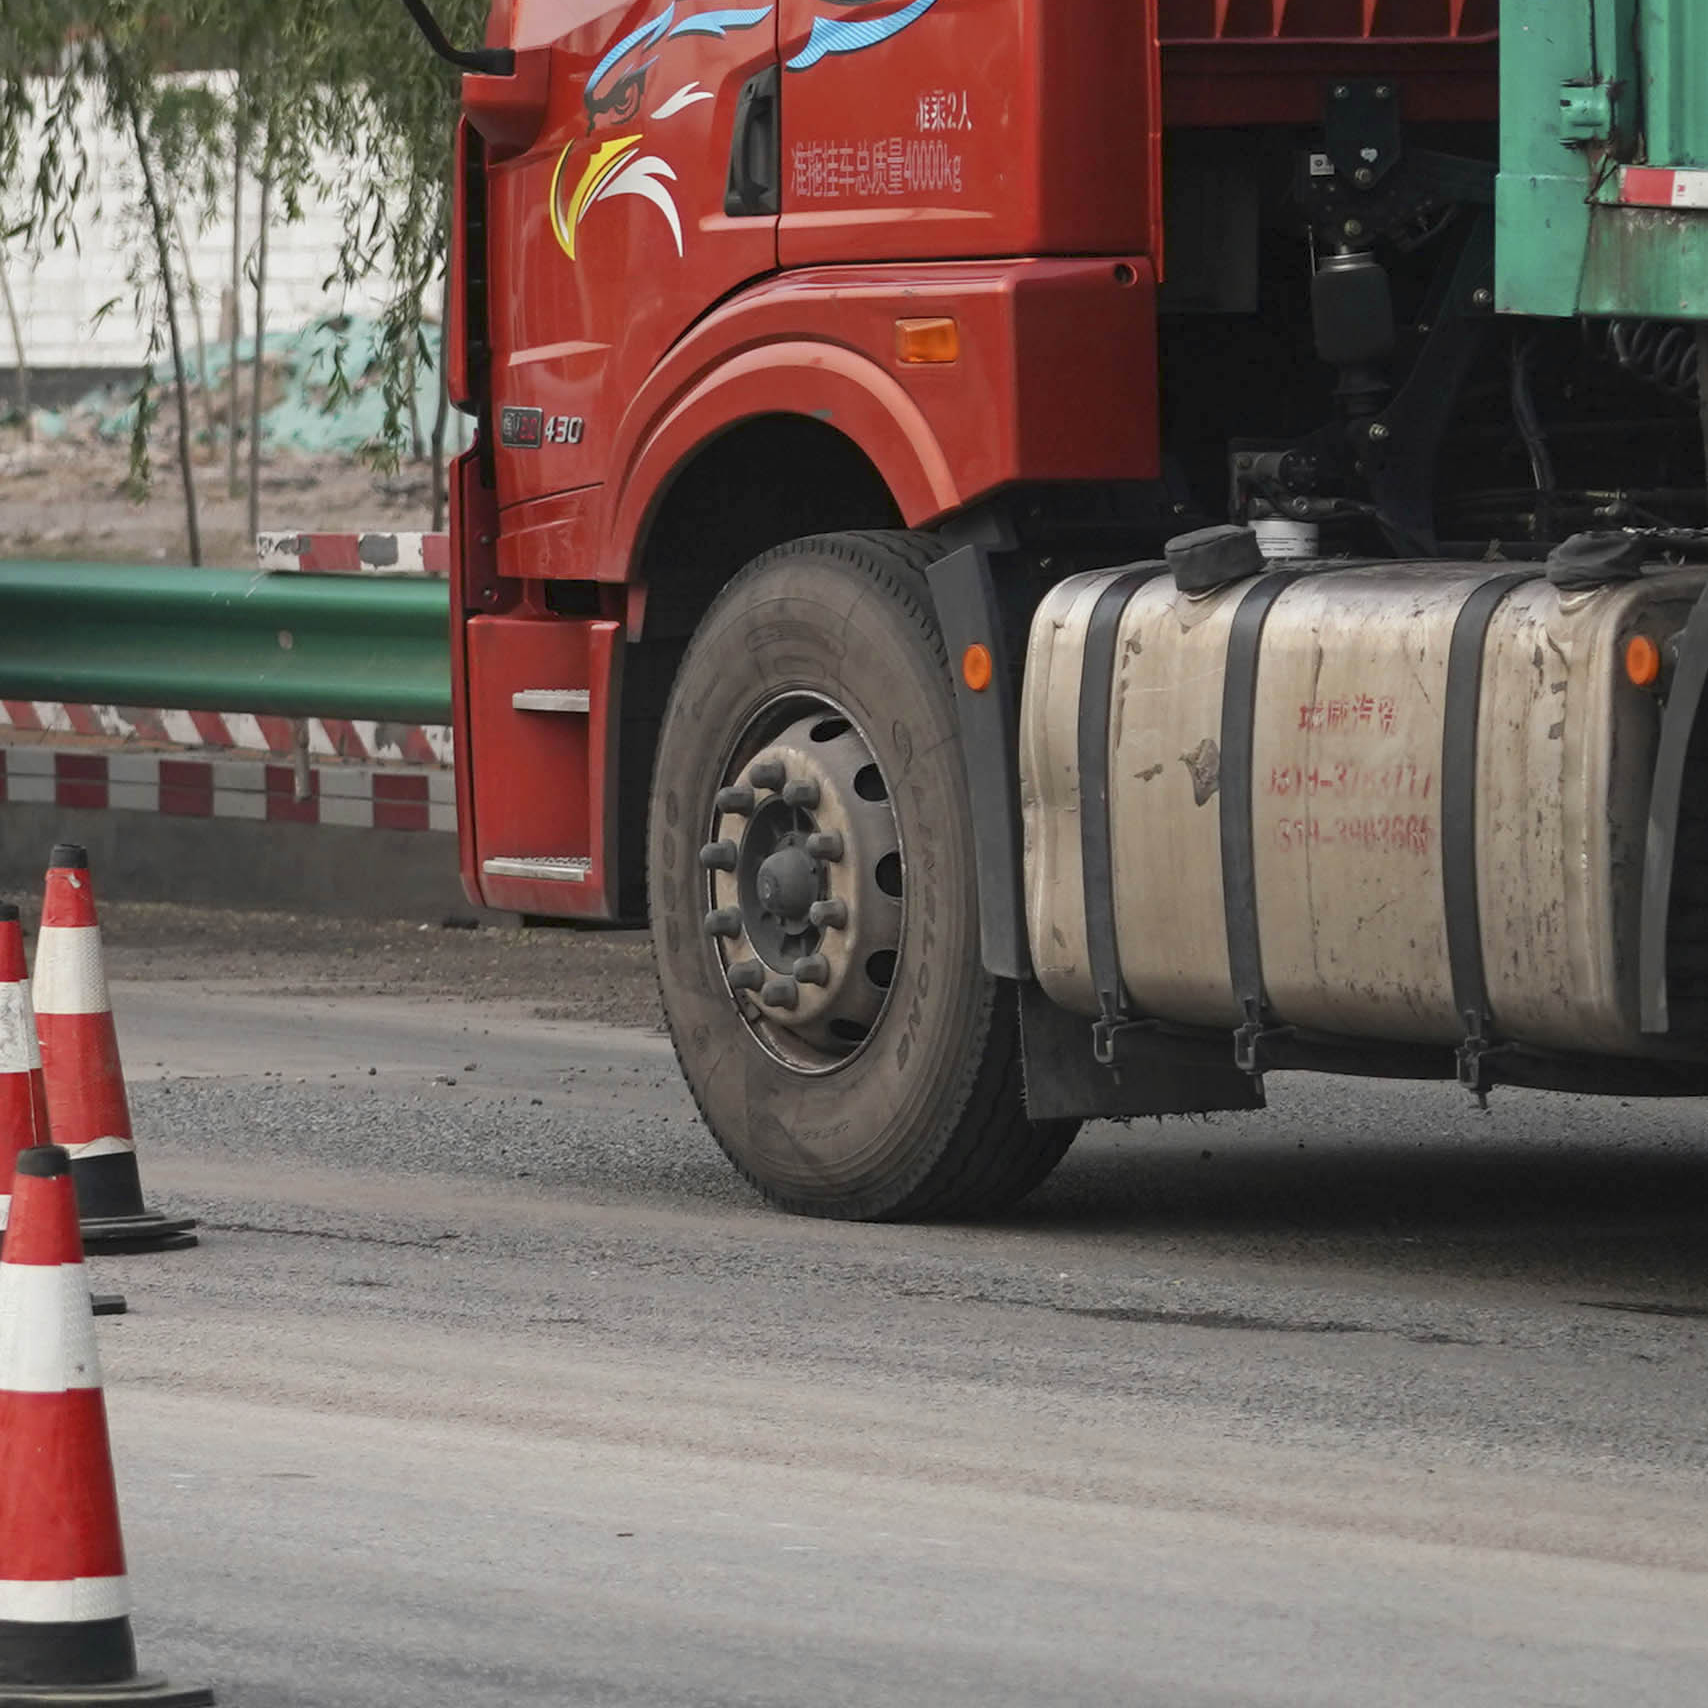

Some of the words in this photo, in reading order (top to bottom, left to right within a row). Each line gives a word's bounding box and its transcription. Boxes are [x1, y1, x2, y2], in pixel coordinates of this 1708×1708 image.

[916, 90, 973, 132] 准乘2人
[545, 415, 583, 444] 430
